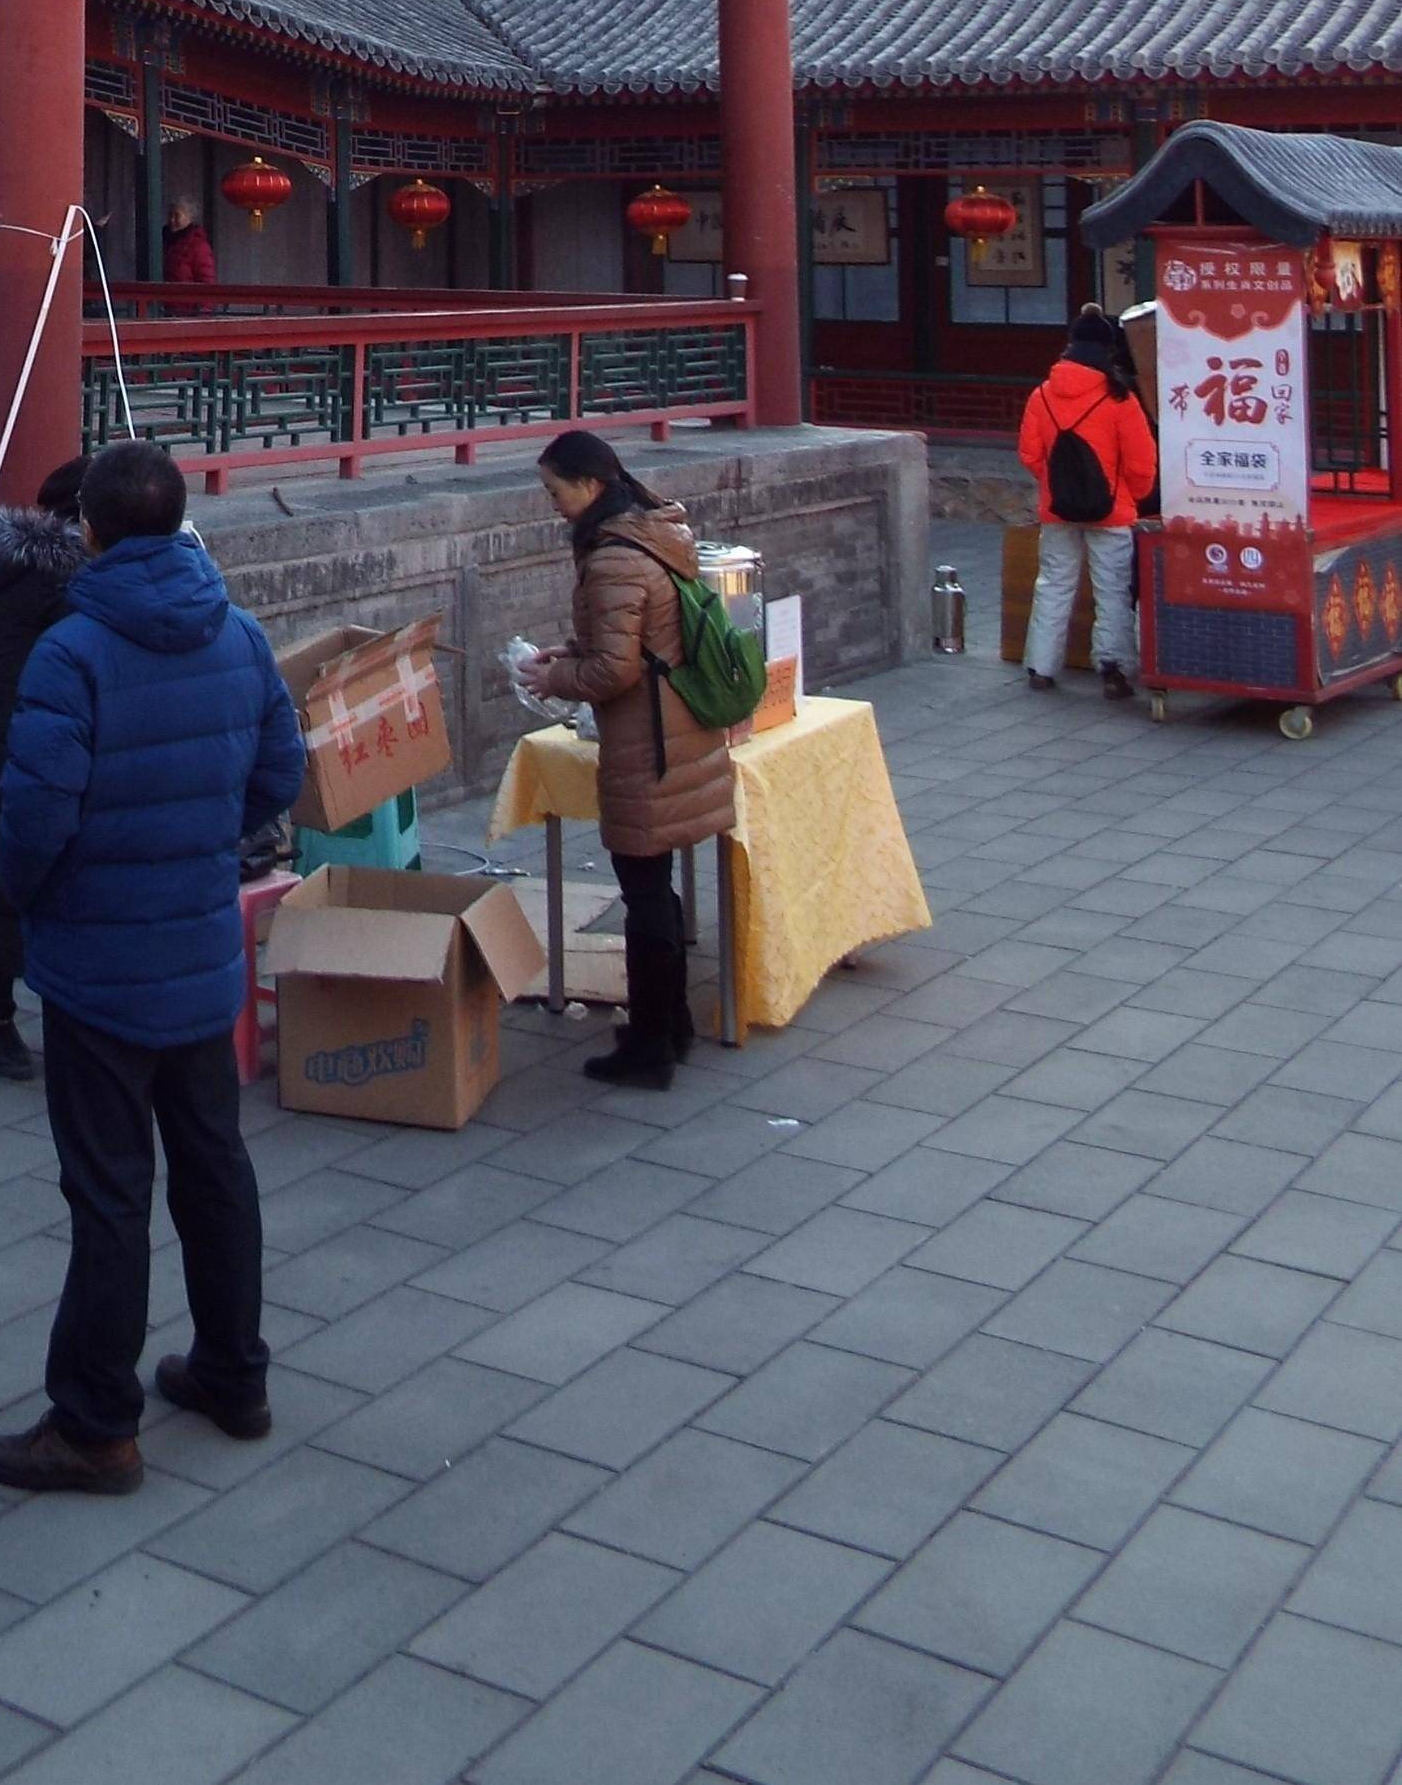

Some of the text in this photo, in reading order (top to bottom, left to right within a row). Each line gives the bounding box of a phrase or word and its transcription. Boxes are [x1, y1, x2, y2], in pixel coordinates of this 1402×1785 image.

[1200, 261, 1293, 277] 授权限量
[1193, 356, 1269, 427] 福
[1200, 450, 1267, 469] 全家福袋
